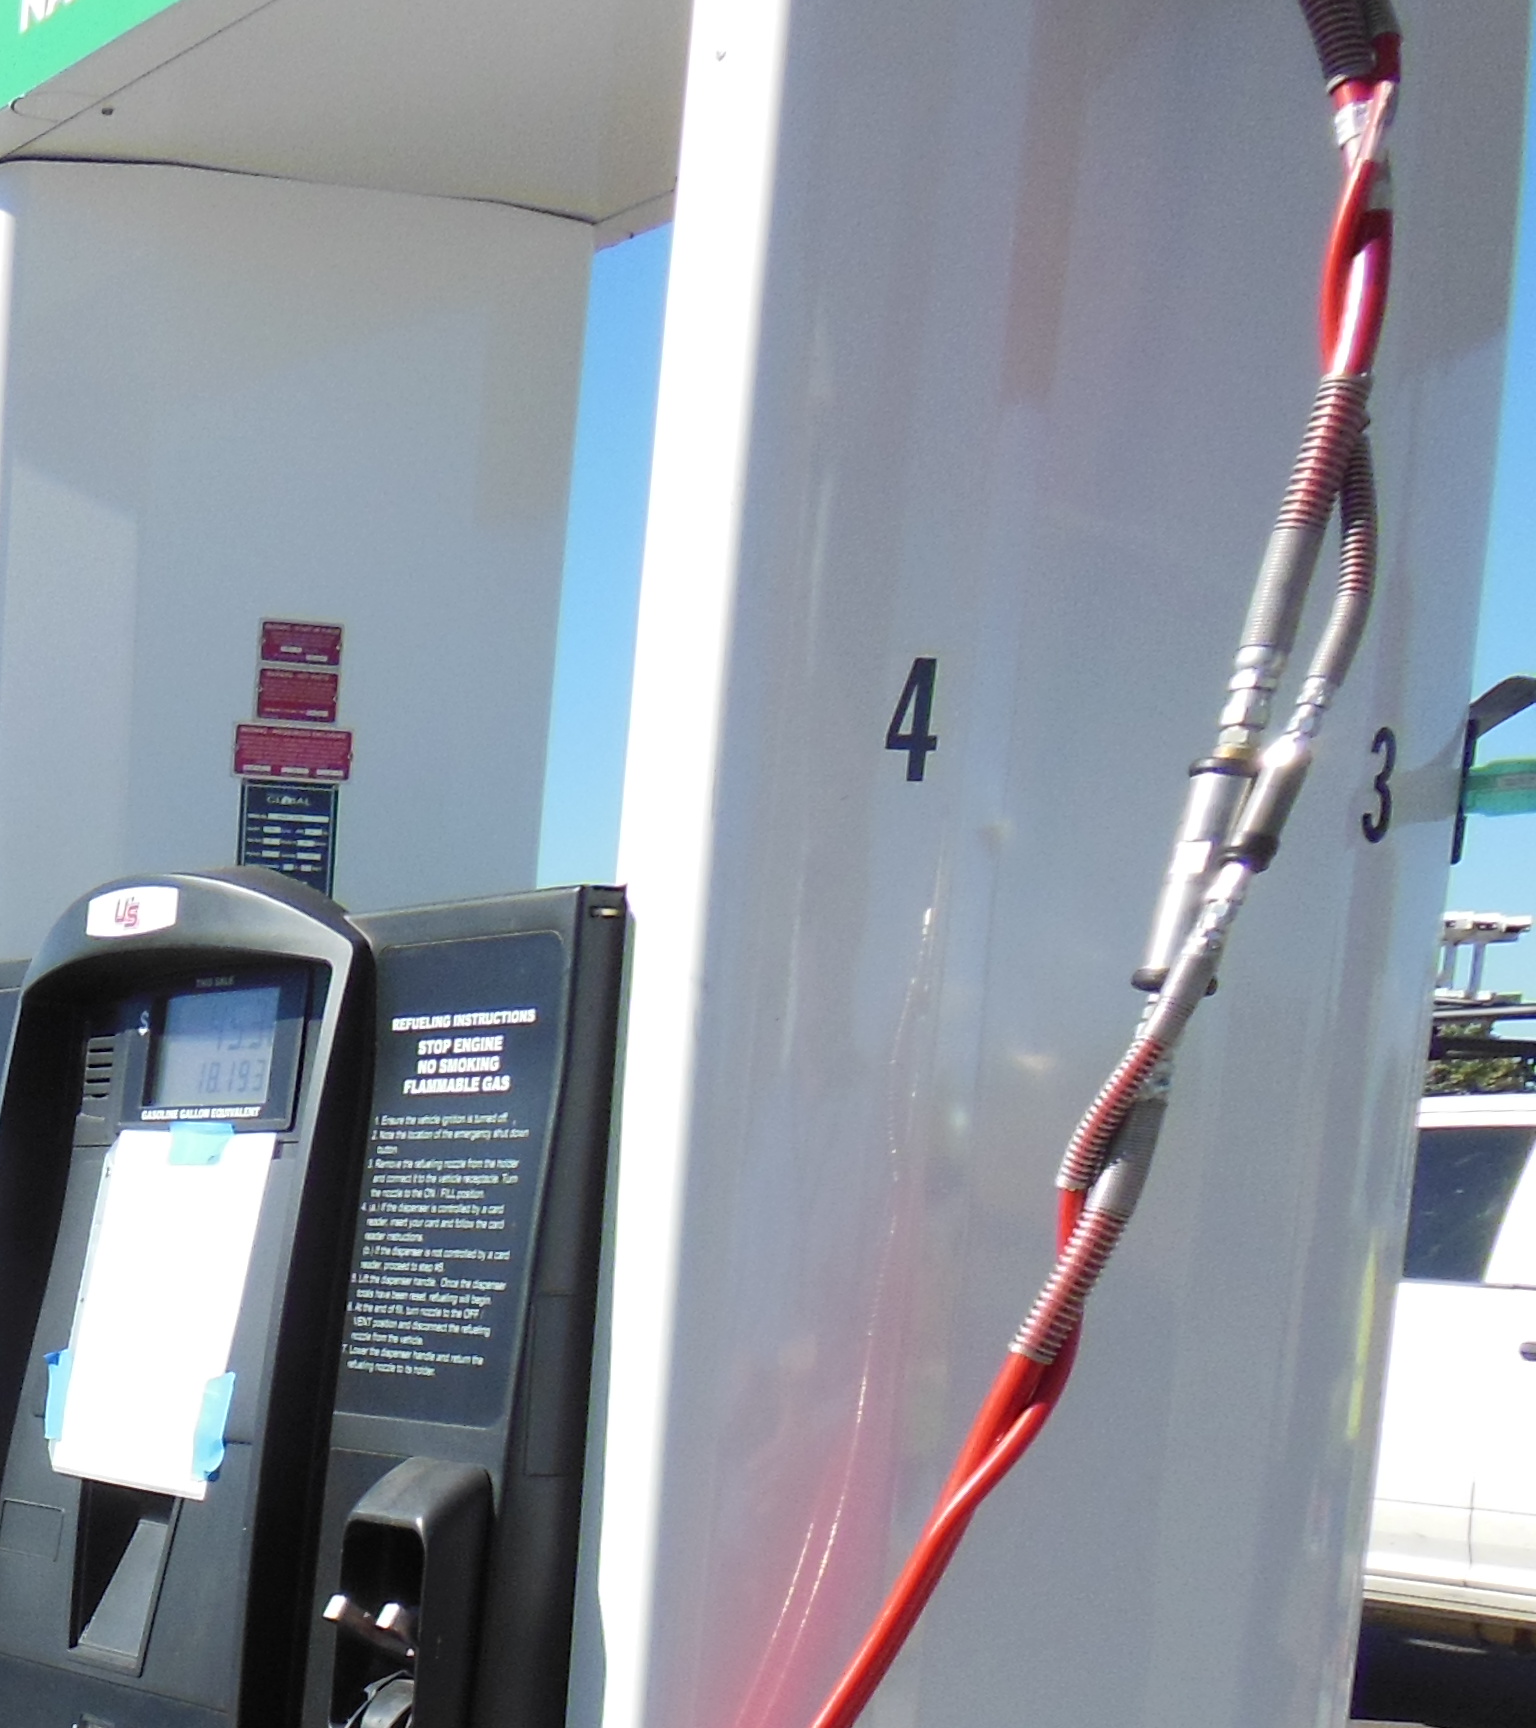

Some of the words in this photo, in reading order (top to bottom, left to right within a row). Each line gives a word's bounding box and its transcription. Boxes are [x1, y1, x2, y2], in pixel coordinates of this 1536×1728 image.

[885, 656, 939, 782] 4
[1361, 726, 1398, 844] 3
[392, 1014, 452, 1031] REFUELING
[453, 1008, 537, 1027] INSTRUCTIONS
[417, 1038, 452, 1055] STOP
[453, 1035, 505, 1053] ENGINE
[417, 1059, 437, 1075] NO
[439, 1056, 501, 1073] SMOKING
[402, 1077, 481, 1094] FLAMMABLE
[482, 1075, 511, 1092] GAS
[141, 1109, 179, 1121] GASOLINE
[179, 1107, 211, 1119] GALLON
[210, 1106, 261, 1119] EQUIVALENT
